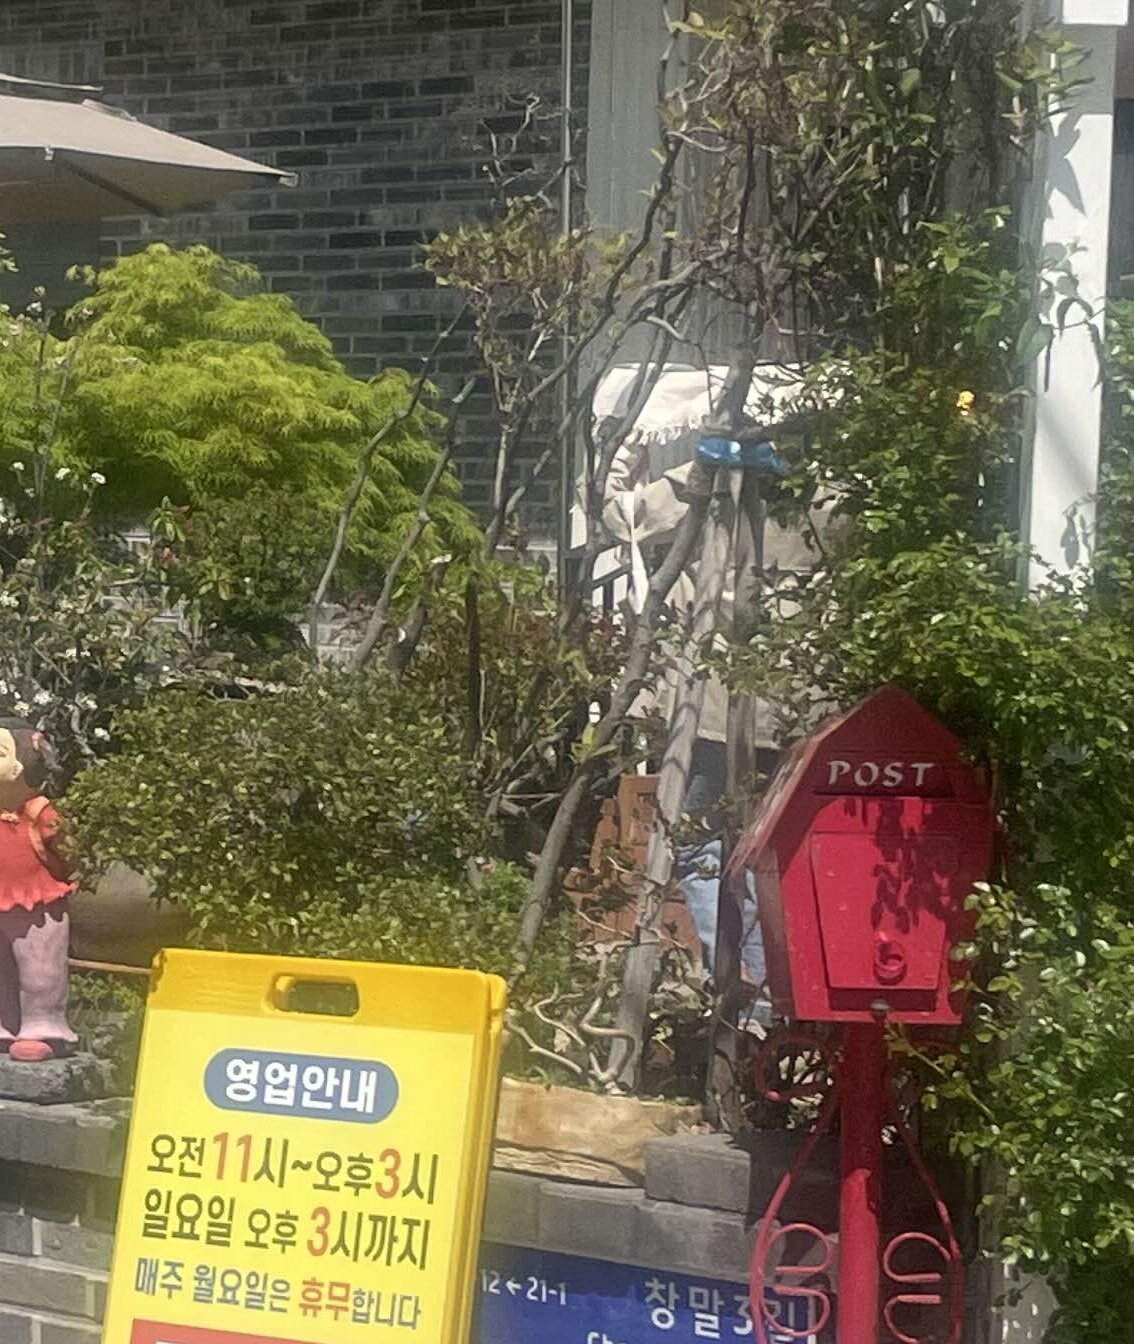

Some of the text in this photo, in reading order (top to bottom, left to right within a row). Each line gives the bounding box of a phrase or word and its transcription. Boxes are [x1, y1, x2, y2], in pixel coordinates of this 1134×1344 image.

[828, 760, 936, 787] POST
[224, 1056, 378, 1115] 영업안내
[141, 1188, 432, 1271] 일요일 오후 3시까지
[134, 1257, 422, 1330] 매주 월요일은 휴무합니다
[526, 1276, 567, 1306] 21-1
